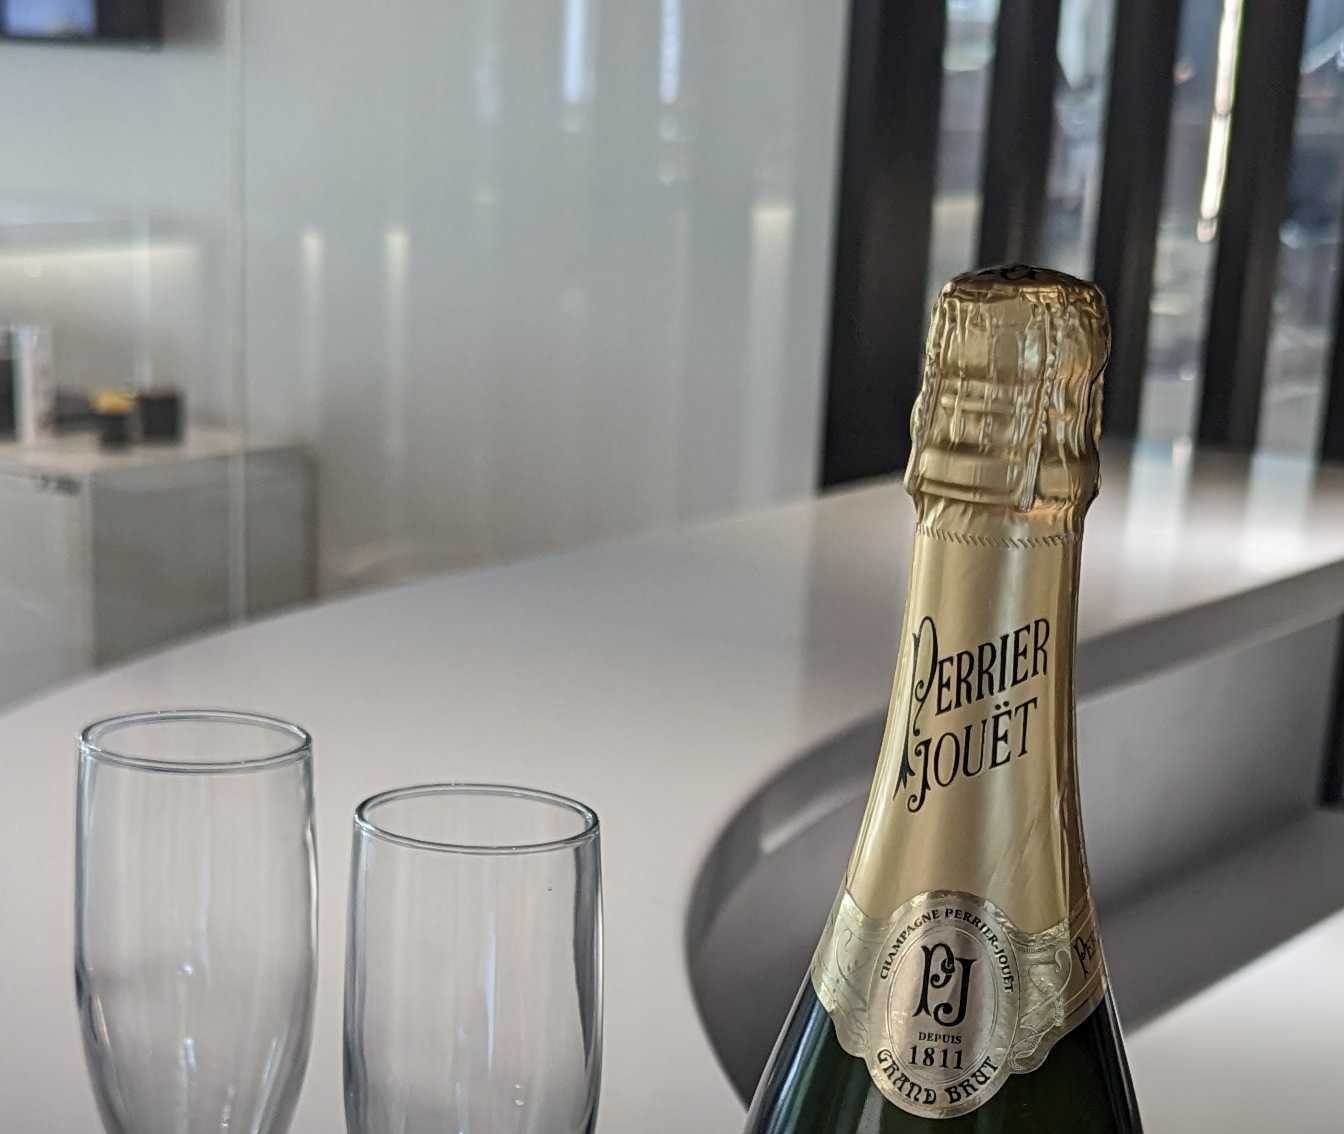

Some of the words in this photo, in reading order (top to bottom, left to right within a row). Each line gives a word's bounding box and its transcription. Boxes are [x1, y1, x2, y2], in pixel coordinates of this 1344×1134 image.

[893, 616, 1050, 800] PERRIER
[907, 697, 1038, 813] JOUËT
[880, 908, 942, 980] CHAMPAGNE
[912, 943, 978, 1027] PJ
[908, 1045, 964, 1070] 1811
[918, 1031, 962, 1045] DEPUIS
[877, 1048, 937, 1105] GRAND
[944, 1056, 999, 1104] BRUT
